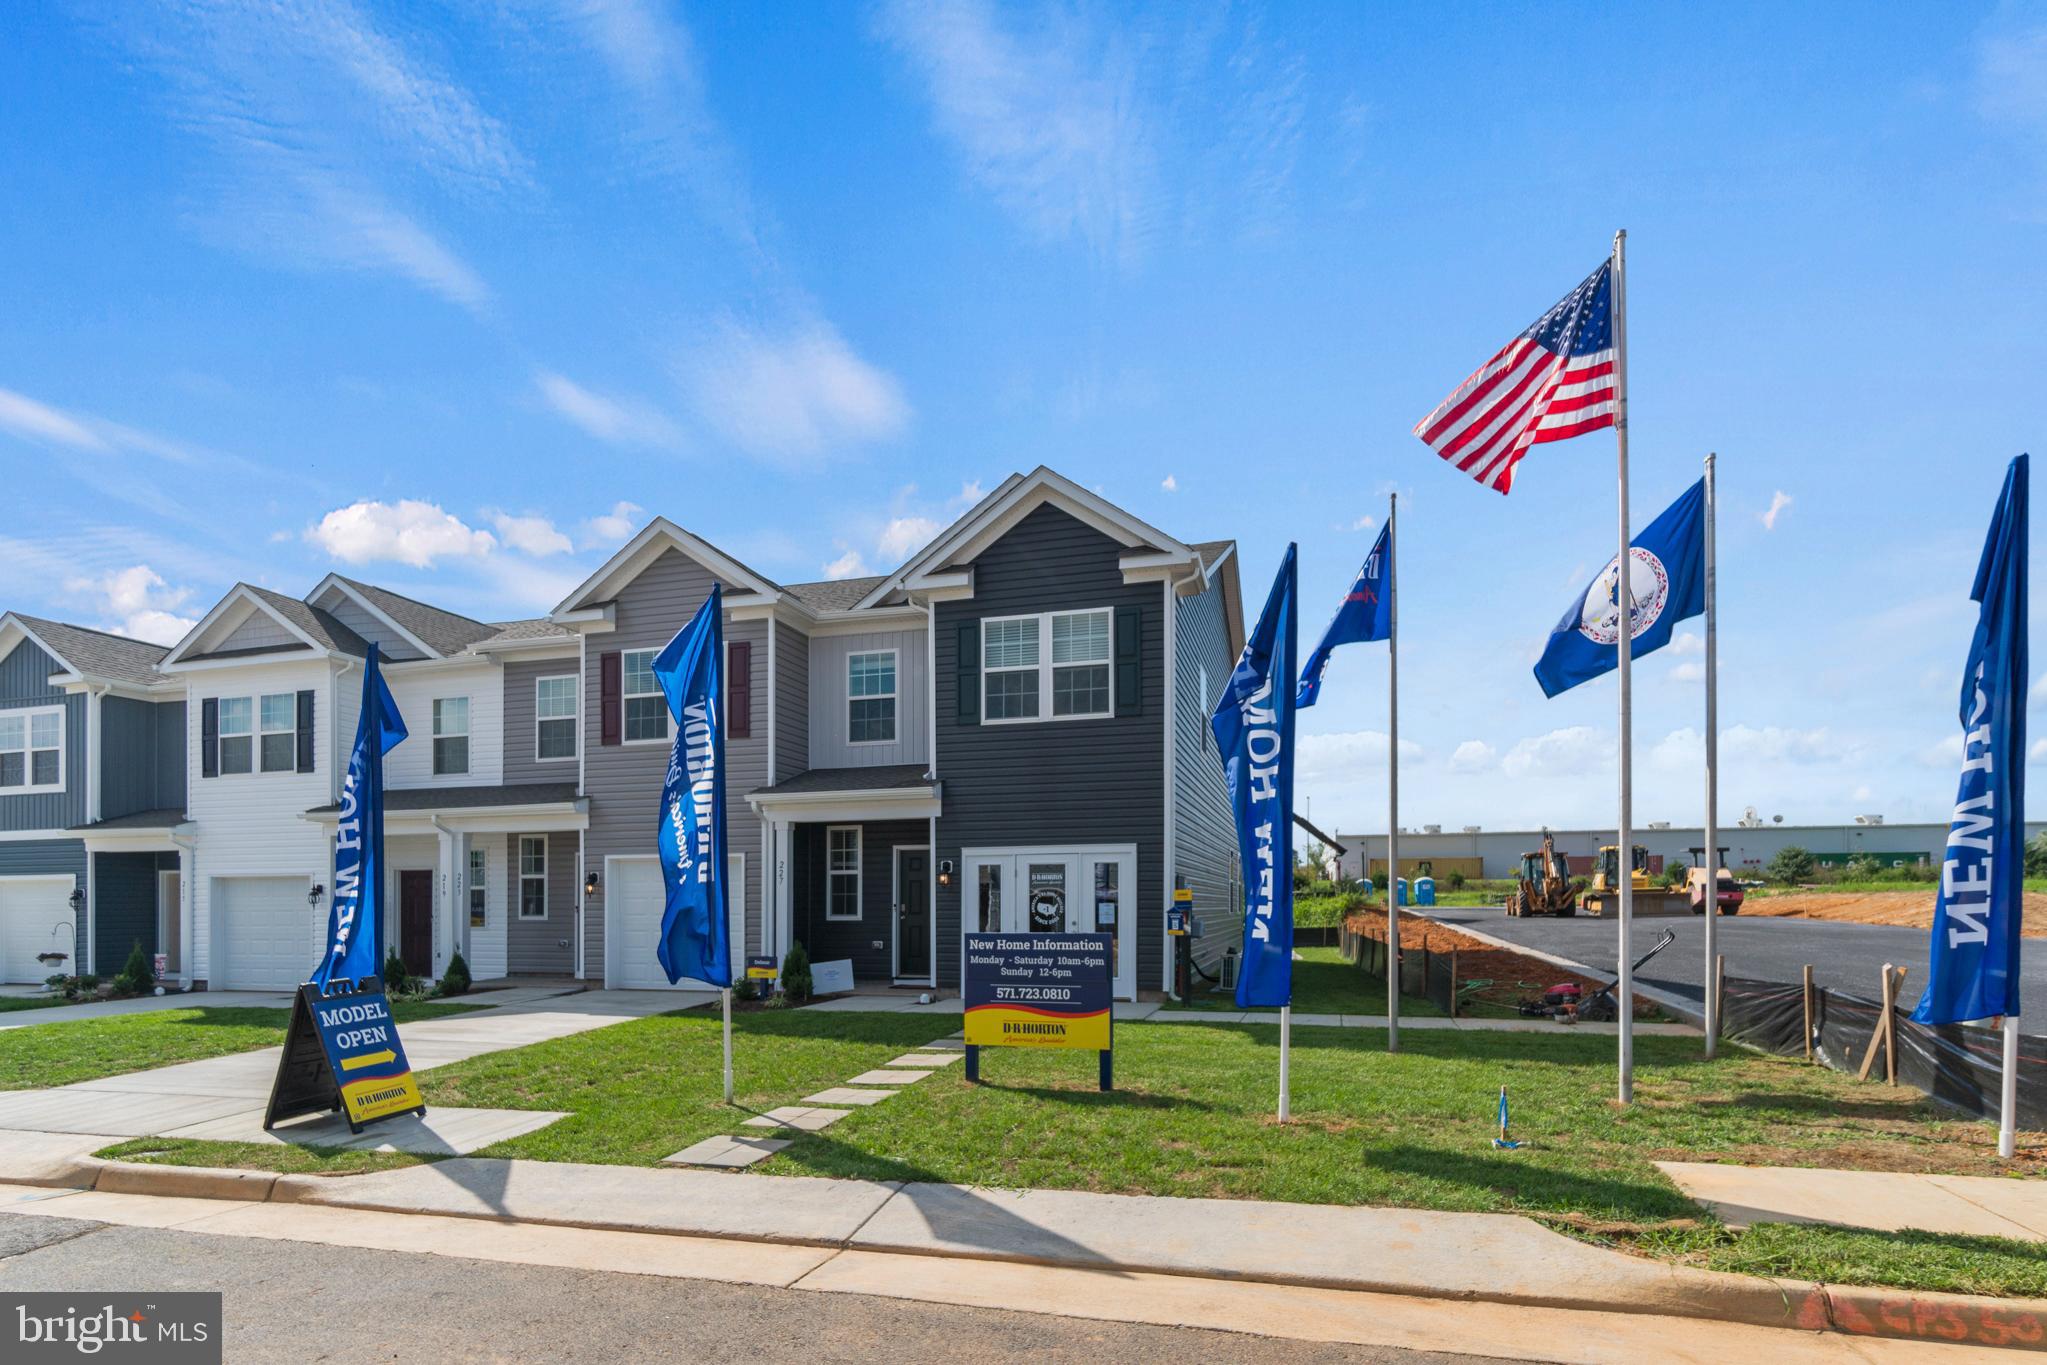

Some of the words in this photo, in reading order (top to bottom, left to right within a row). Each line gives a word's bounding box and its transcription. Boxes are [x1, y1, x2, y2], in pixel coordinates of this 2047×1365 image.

[969, 939, 994, 950] New
[997, 939, 1030, 950] Home
[1033, 939, 1104, 951] Information
[970, 955, 1005, 966] Monday
[1014, 956, 1054, 967] Saturday
[1057, 957, 1105, 968] 10am-6pm
[1000, 967, 1033, 978] Sunday
[1039, 968, 1072, 979] 12-6pm
[996, 987, 1071, 1000] 571.723.0810
[320, 1002, 389, 1027] MODEL
[336, 1026, 388, 1049] OPEN
